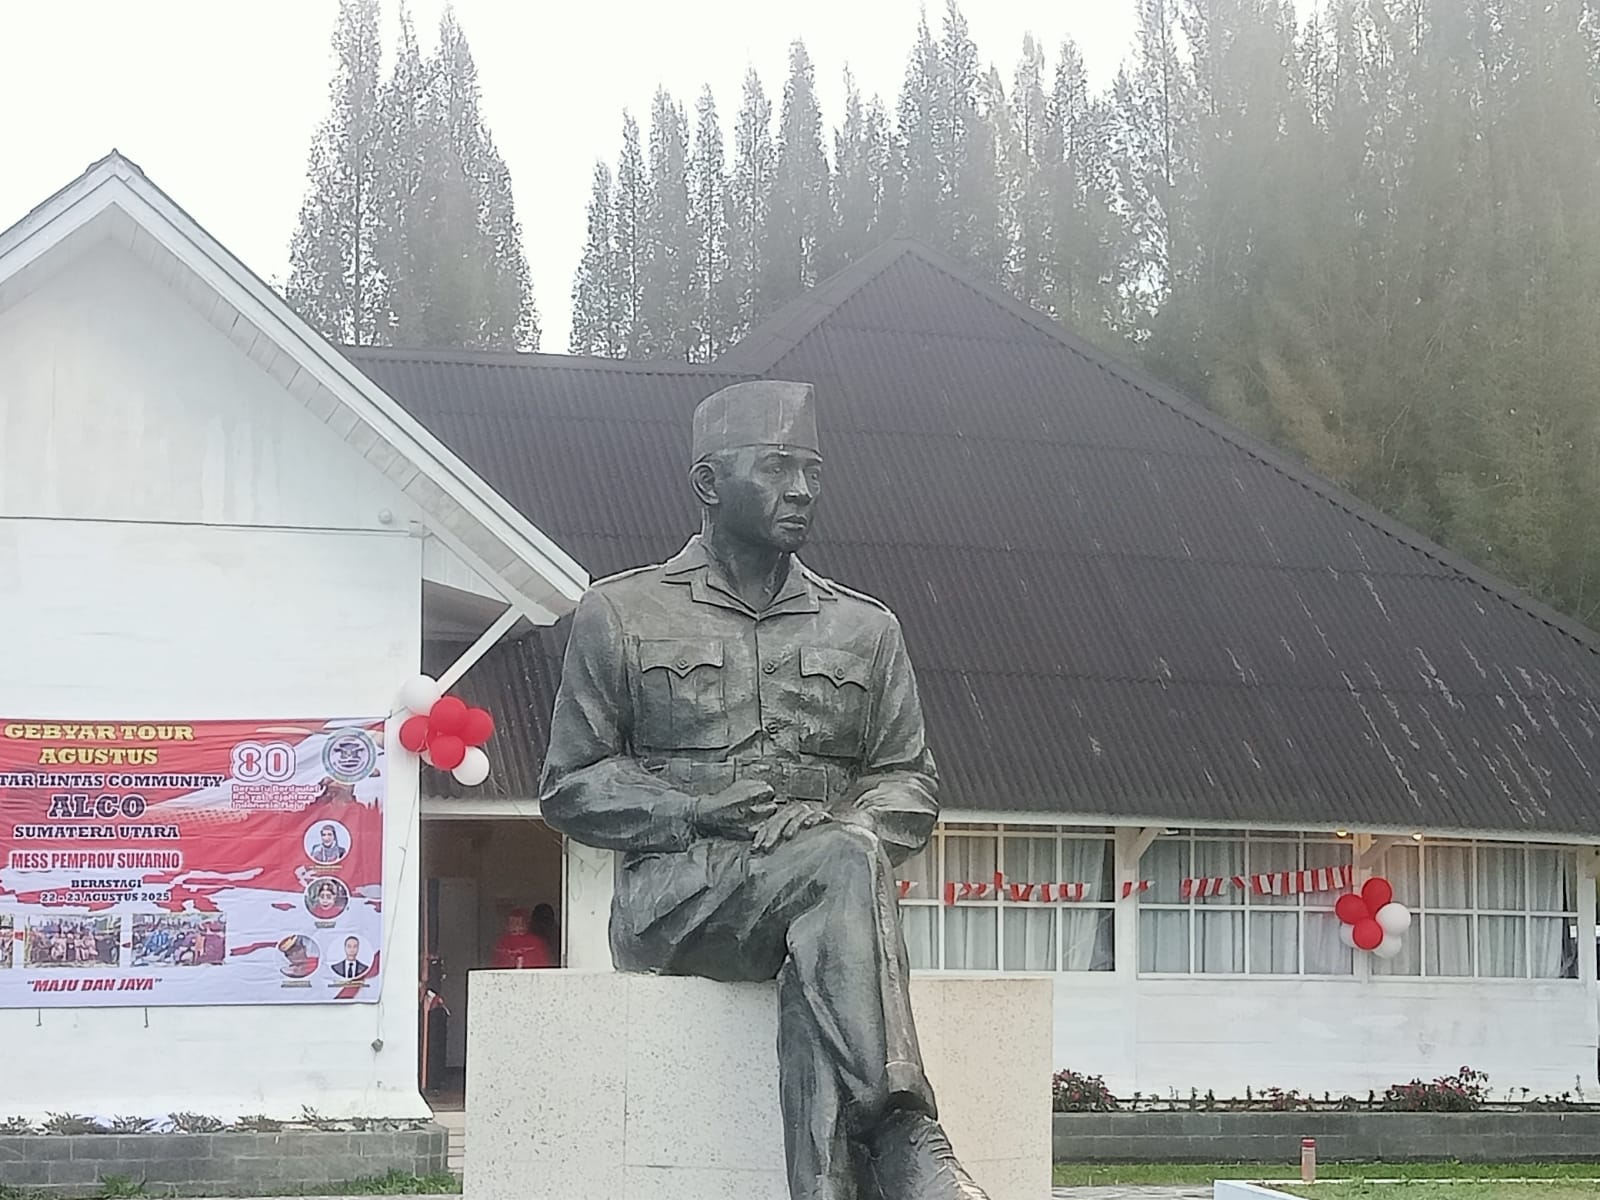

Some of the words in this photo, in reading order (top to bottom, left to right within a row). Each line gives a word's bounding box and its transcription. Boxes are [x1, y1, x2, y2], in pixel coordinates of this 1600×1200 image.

[4, 724, 117, 740] GEBYAR
[121, 725, 194, 740] TOUR
[39, 748, 158, 765] AGUSTUS
[233, 743, 294, 781] 80
[38, 775, 103, 787] LINTAS
[109, 775, 222, 788] COMMUNITY
[48, 795, 146, 818] ALCO
[14, 826, 115, 838] SUMATERA
[119, 826, 179, 838] UTARA
[11, 852, 48, 869] MESS
[51, 852, 115, 869] PEMPROV
[117, 851, 180, 869] SUKARNO
[71, 879, 142, 889] BERASTAGI
[41, 892, 56, 902] 22
[65, 892, 81, 902] 23
[84, 892, 139, 902] AGUSTUS
[141, 891, 170, 902] 2025
[82, 979, 116, 992] DAN
